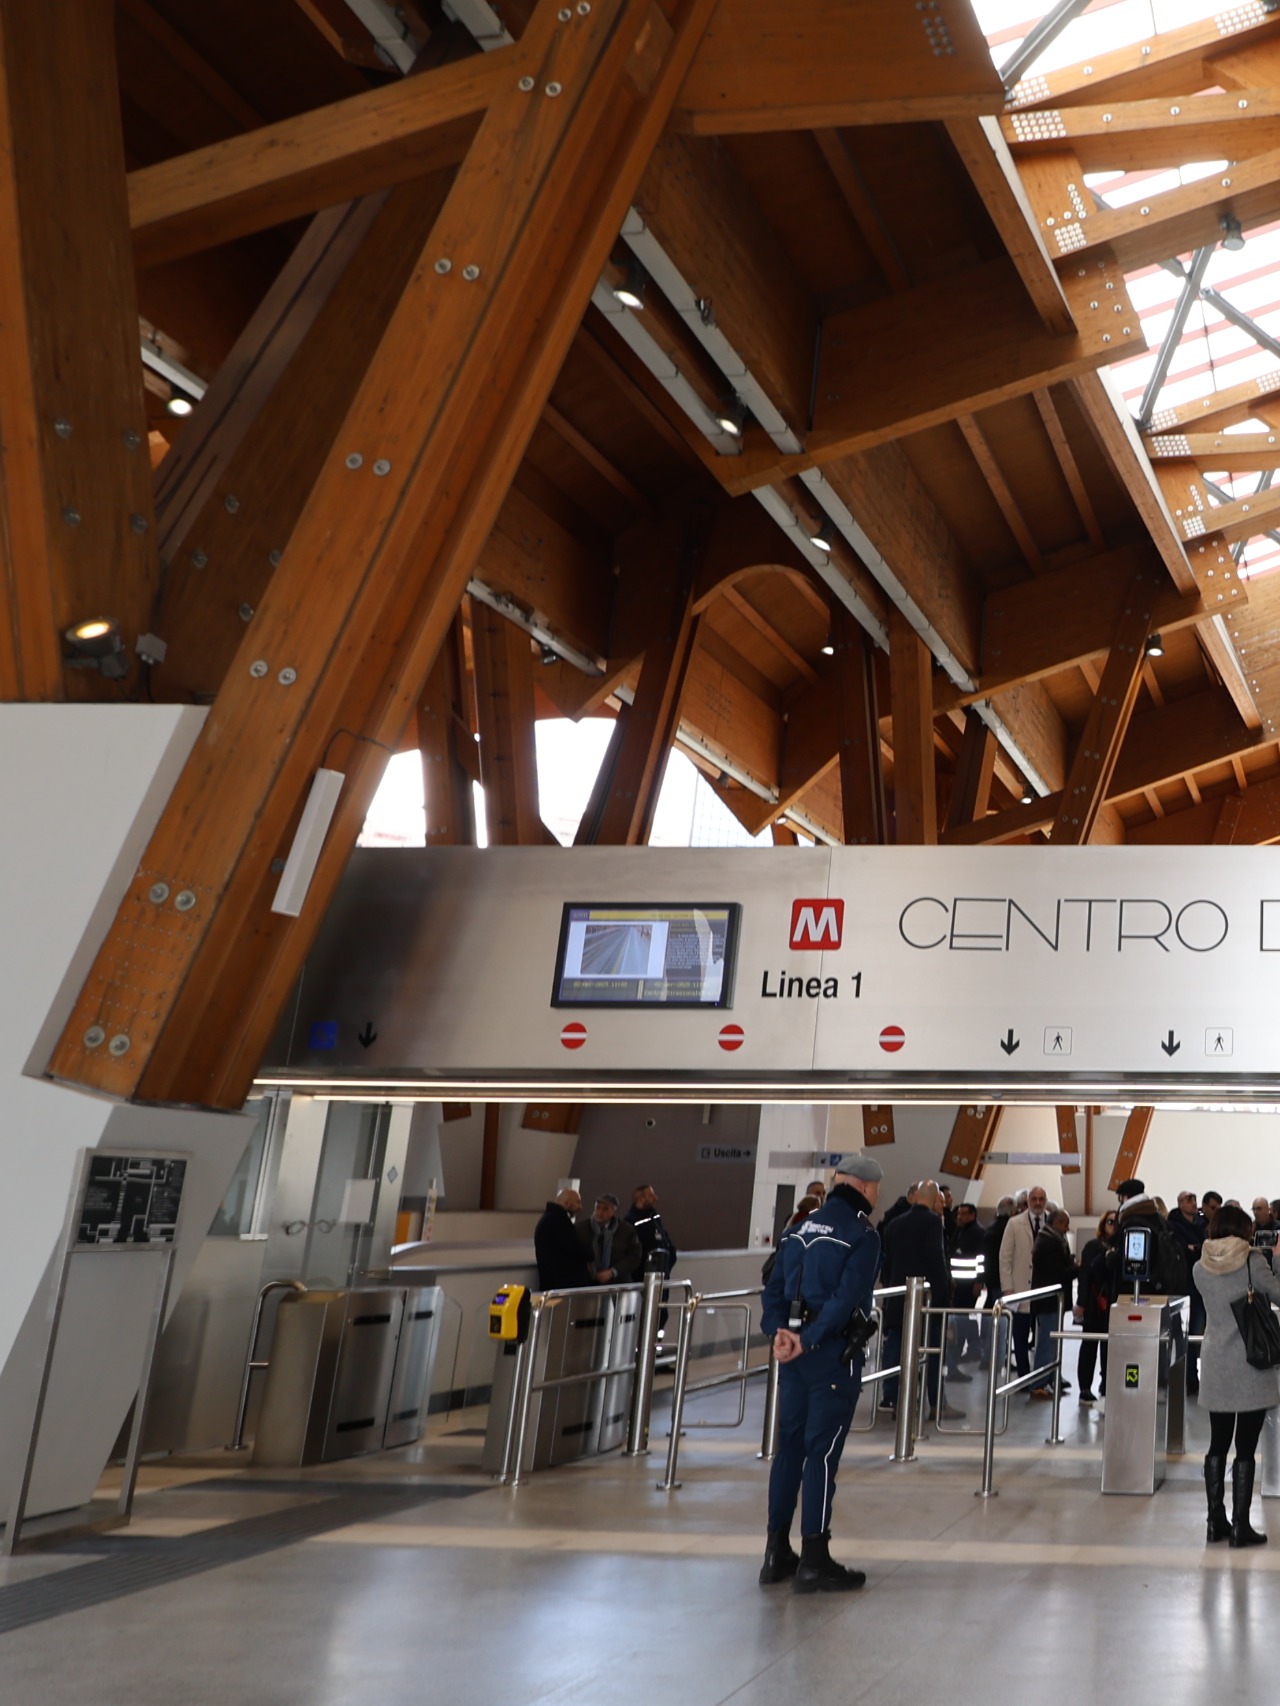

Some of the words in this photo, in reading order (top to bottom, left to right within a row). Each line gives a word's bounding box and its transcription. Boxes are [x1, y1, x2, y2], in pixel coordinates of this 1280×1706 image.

[793, 907, 839, 942] M
[898, 896, 1230, 953] CENTRO
[761, 970, 839, 999] Linea
[851, 971, 862, 998] 1
[714, 1147, 742, 1159] Uscita
